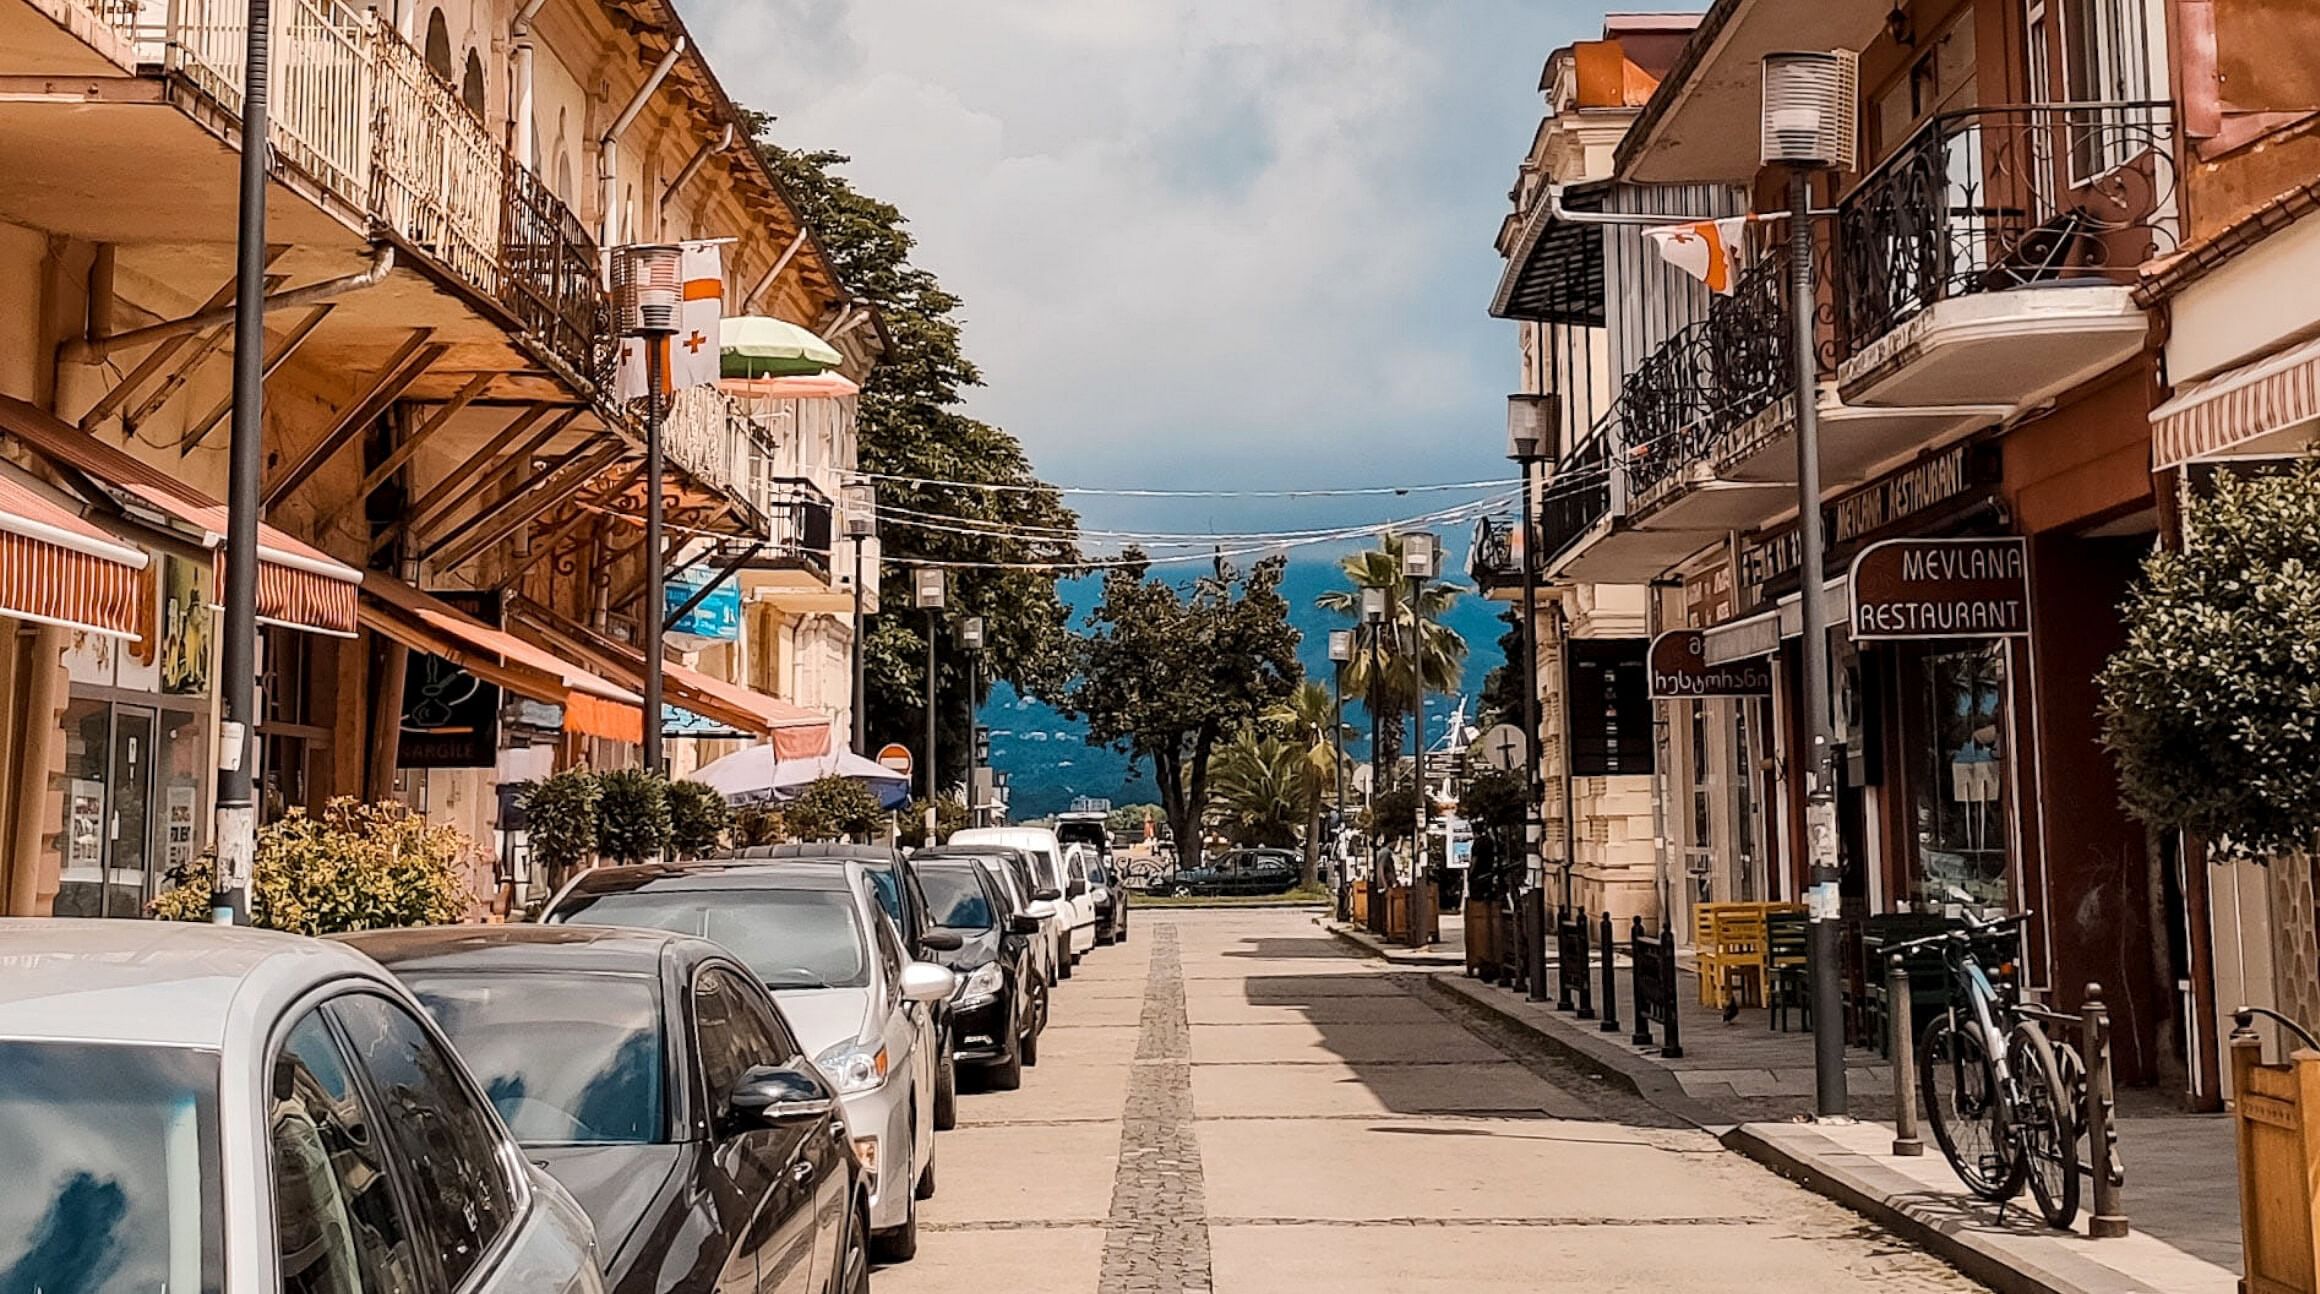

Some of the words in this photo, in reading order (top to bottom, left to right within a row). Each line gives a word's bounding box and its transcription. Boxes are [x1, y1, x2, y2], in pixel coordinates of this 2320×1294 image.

[1836, 486, 1882, 542] MEVLANA
[1889, 446, 1963, 521] RESTAURANT
[1903, 549, 2021, 581] MEVLANA
[1860, 600, 2019, 631] RESTAURANT
[1655, 668, 1769, 695] რესტორანი
